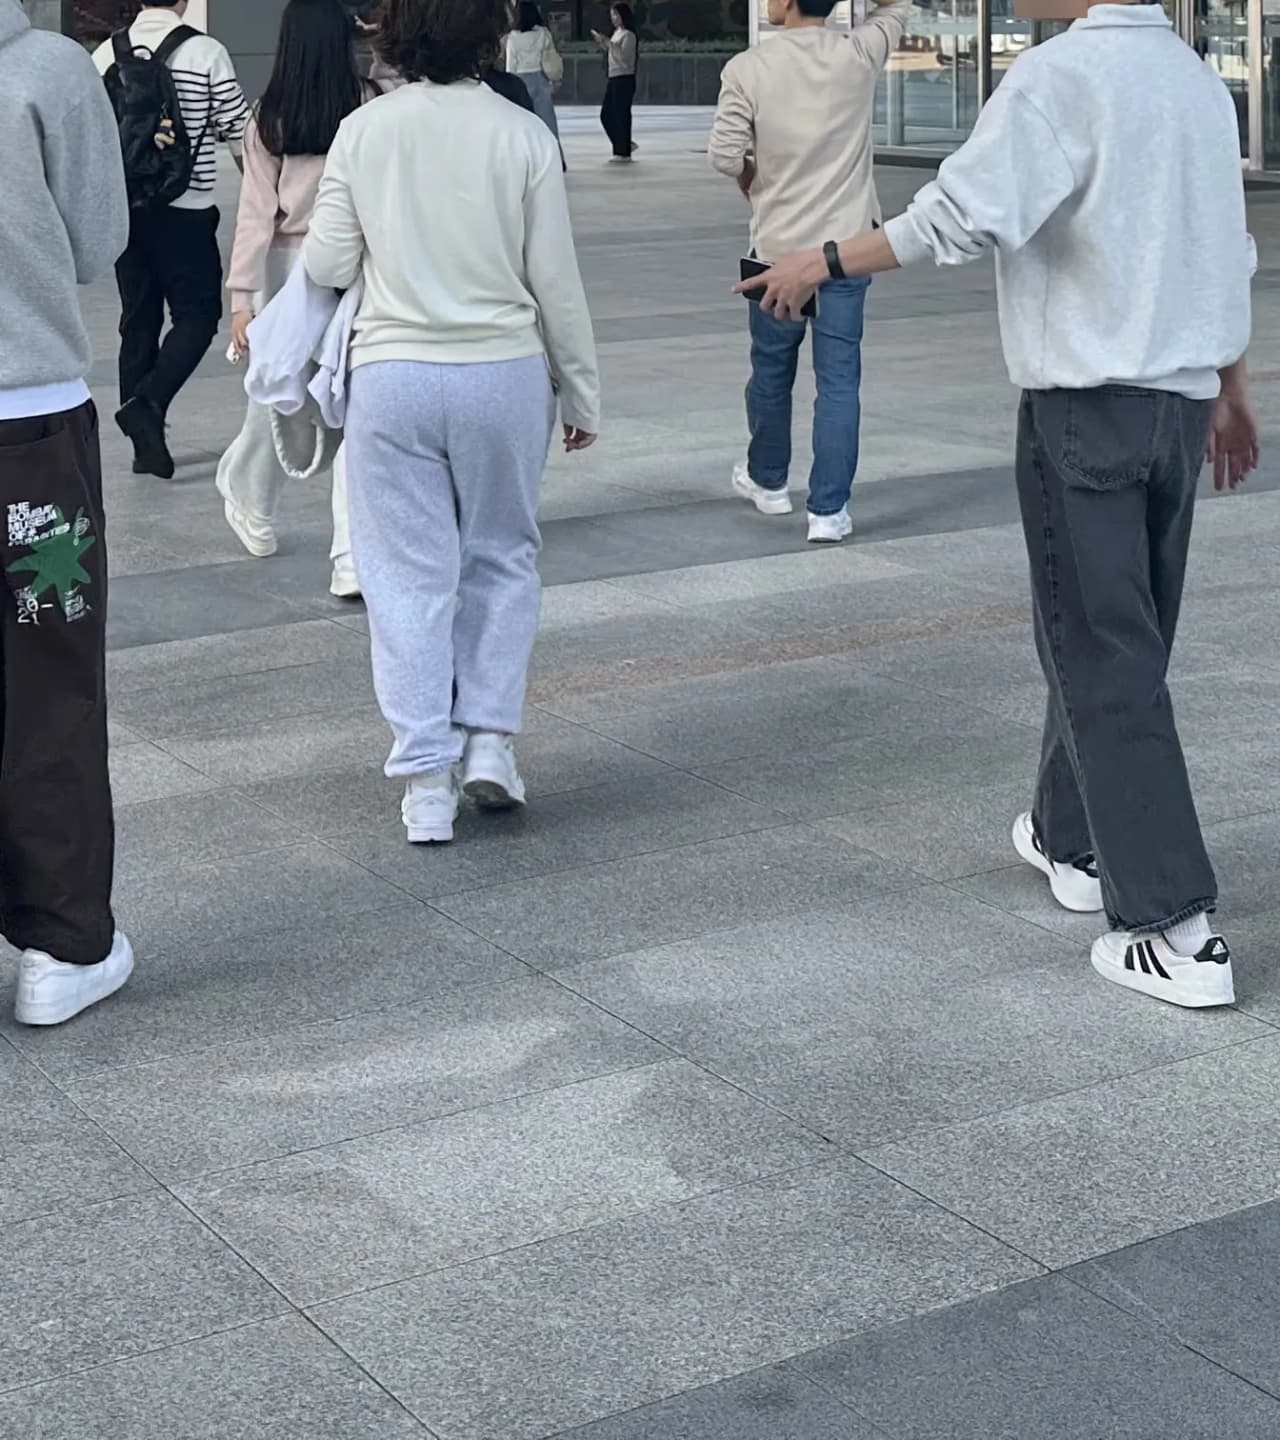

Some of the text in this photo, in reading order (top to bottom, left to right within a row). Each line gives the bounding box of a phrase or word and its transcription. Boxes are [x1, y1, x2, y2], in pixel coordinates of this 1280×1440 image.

[7, 501, 30, 513] THE
[8, 509, 57, 532] MUSEUM
[9, 531, 27, 541] OF
